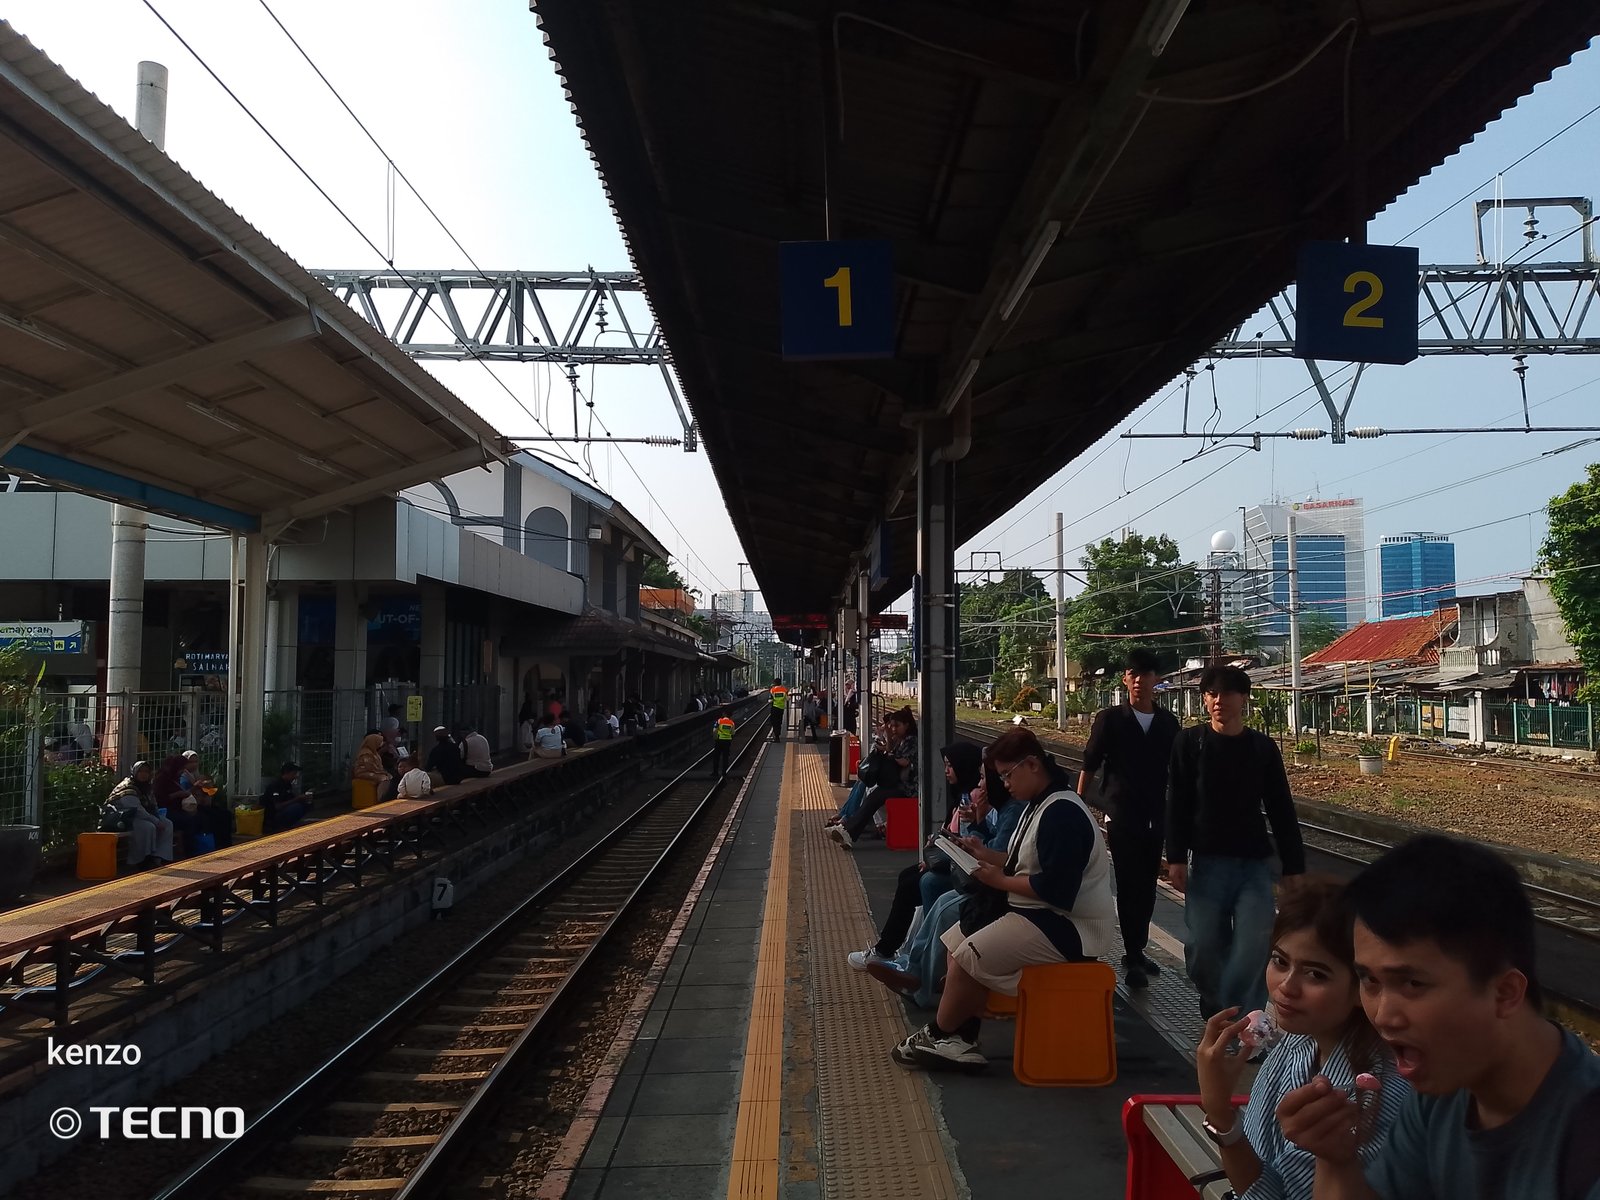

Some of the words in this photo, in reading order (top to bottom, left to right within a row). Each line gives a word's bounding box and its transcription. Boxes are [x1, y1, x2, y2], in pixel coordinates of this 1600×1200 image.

[824, 266, 852, 327] 1
[1343, 270, 1384, 328] 2
[437, 883, 448, 901] 7
